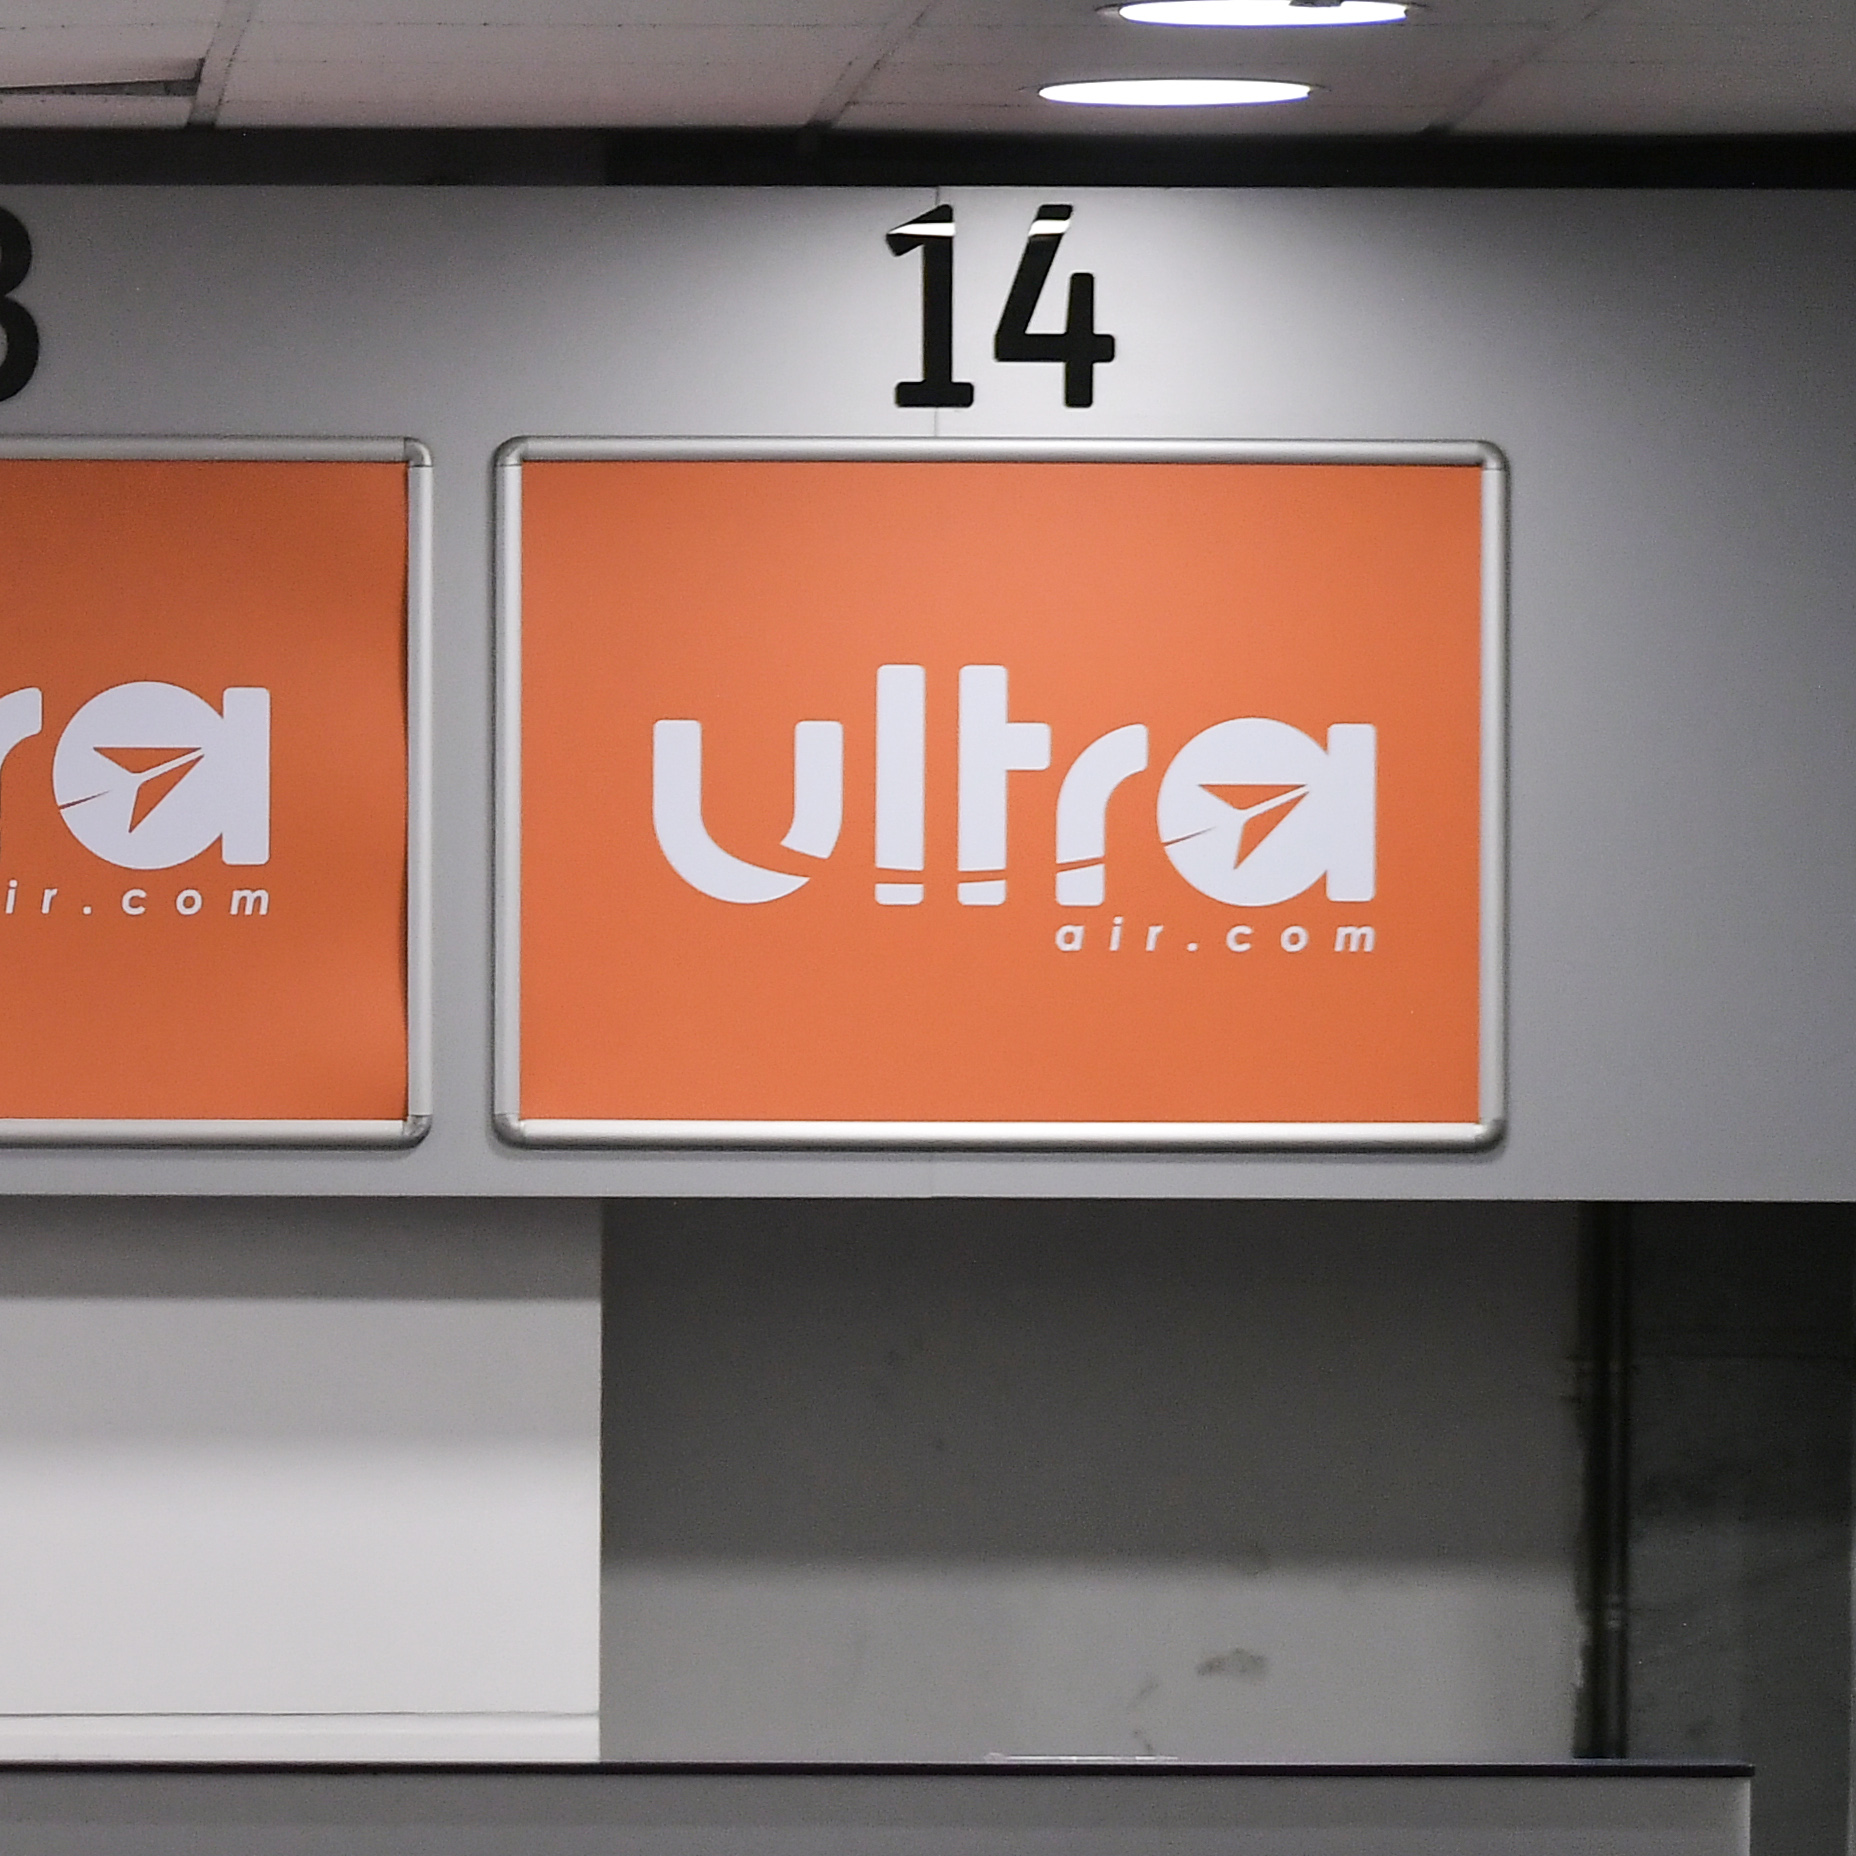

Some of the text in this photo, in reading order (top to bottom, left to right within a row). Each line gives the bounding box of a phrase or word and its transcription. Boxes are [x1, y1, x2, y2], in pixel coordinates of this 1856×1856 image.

[885, 204, 1115, 409] 14
[653, 663, 1378, 907] ultra
[1054, 916, 1377, 953] air.com
